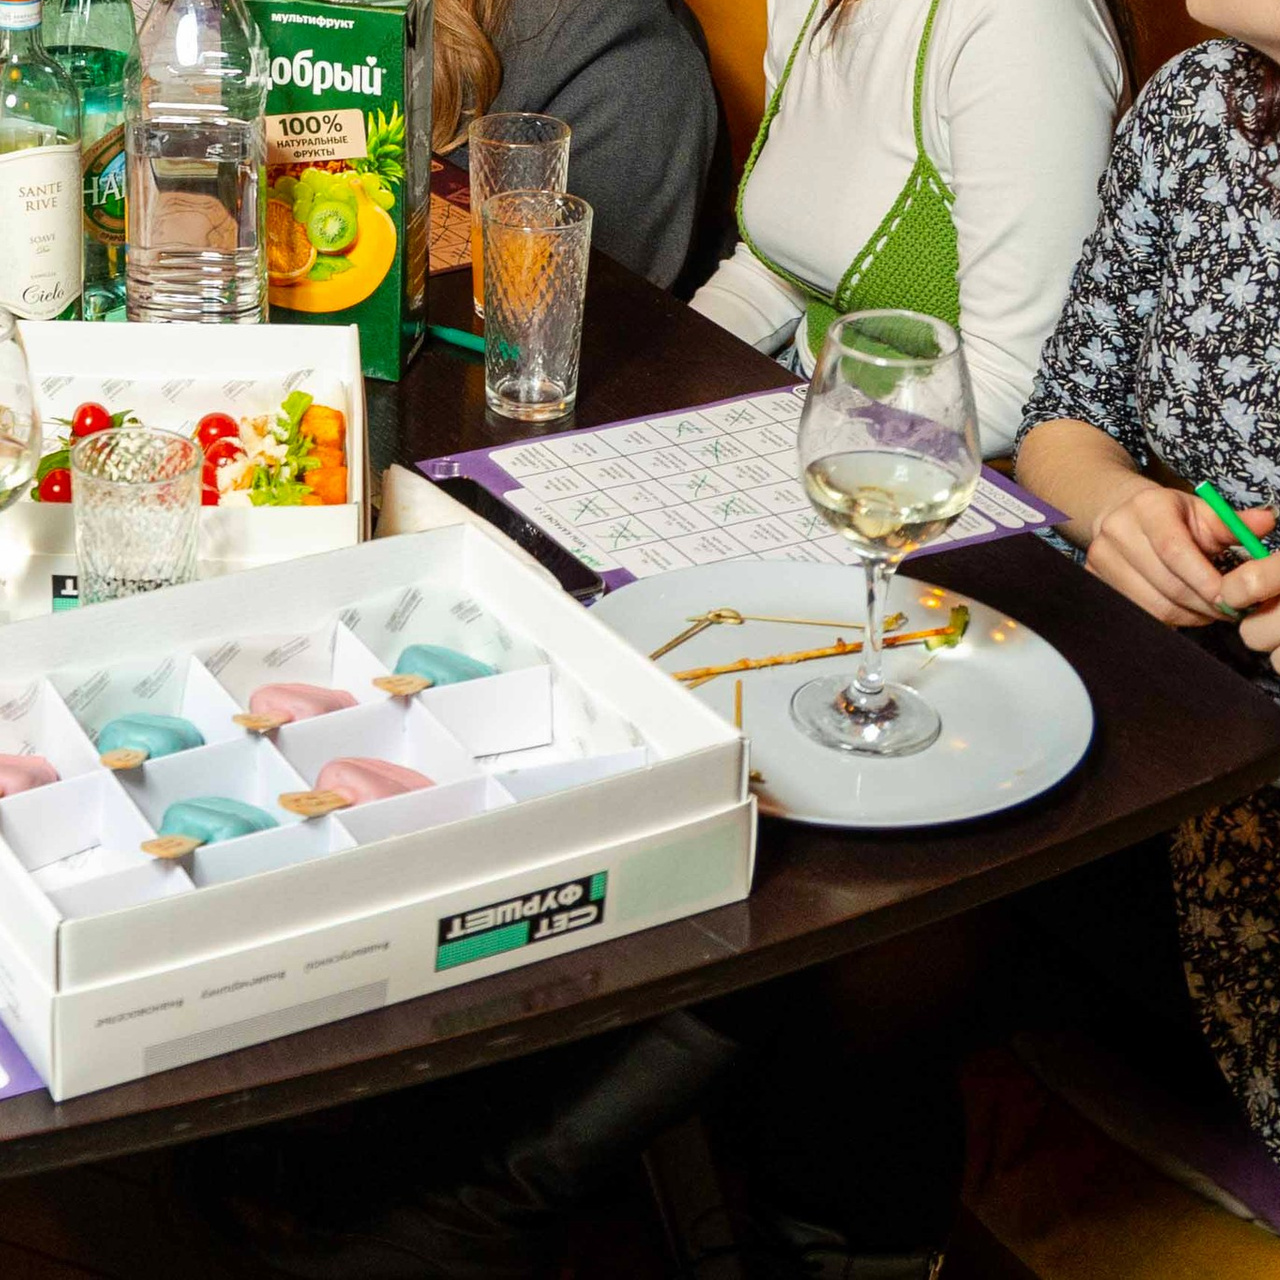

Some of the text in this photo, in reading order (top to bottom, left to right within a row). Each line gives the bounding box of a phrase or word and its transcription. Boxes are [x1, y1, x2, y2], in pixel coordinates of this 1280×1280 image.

[271, 11, 355, 30] мультифрукт
[278, 114, 343, 136] 100%
[276, 135, 349, 149] НАТУРАЛЬНЫЕ
[293, 147, 336, 159] ФРУКТЫ
[18, 181, 63, 198] SANTE
[25, 196, 58, 211] RIVE
[22, 281, 65, 305] Cielo
[446, 883, 584, 940] ФУРШЕТ
[533, 904, 599, 939] СЕТ
